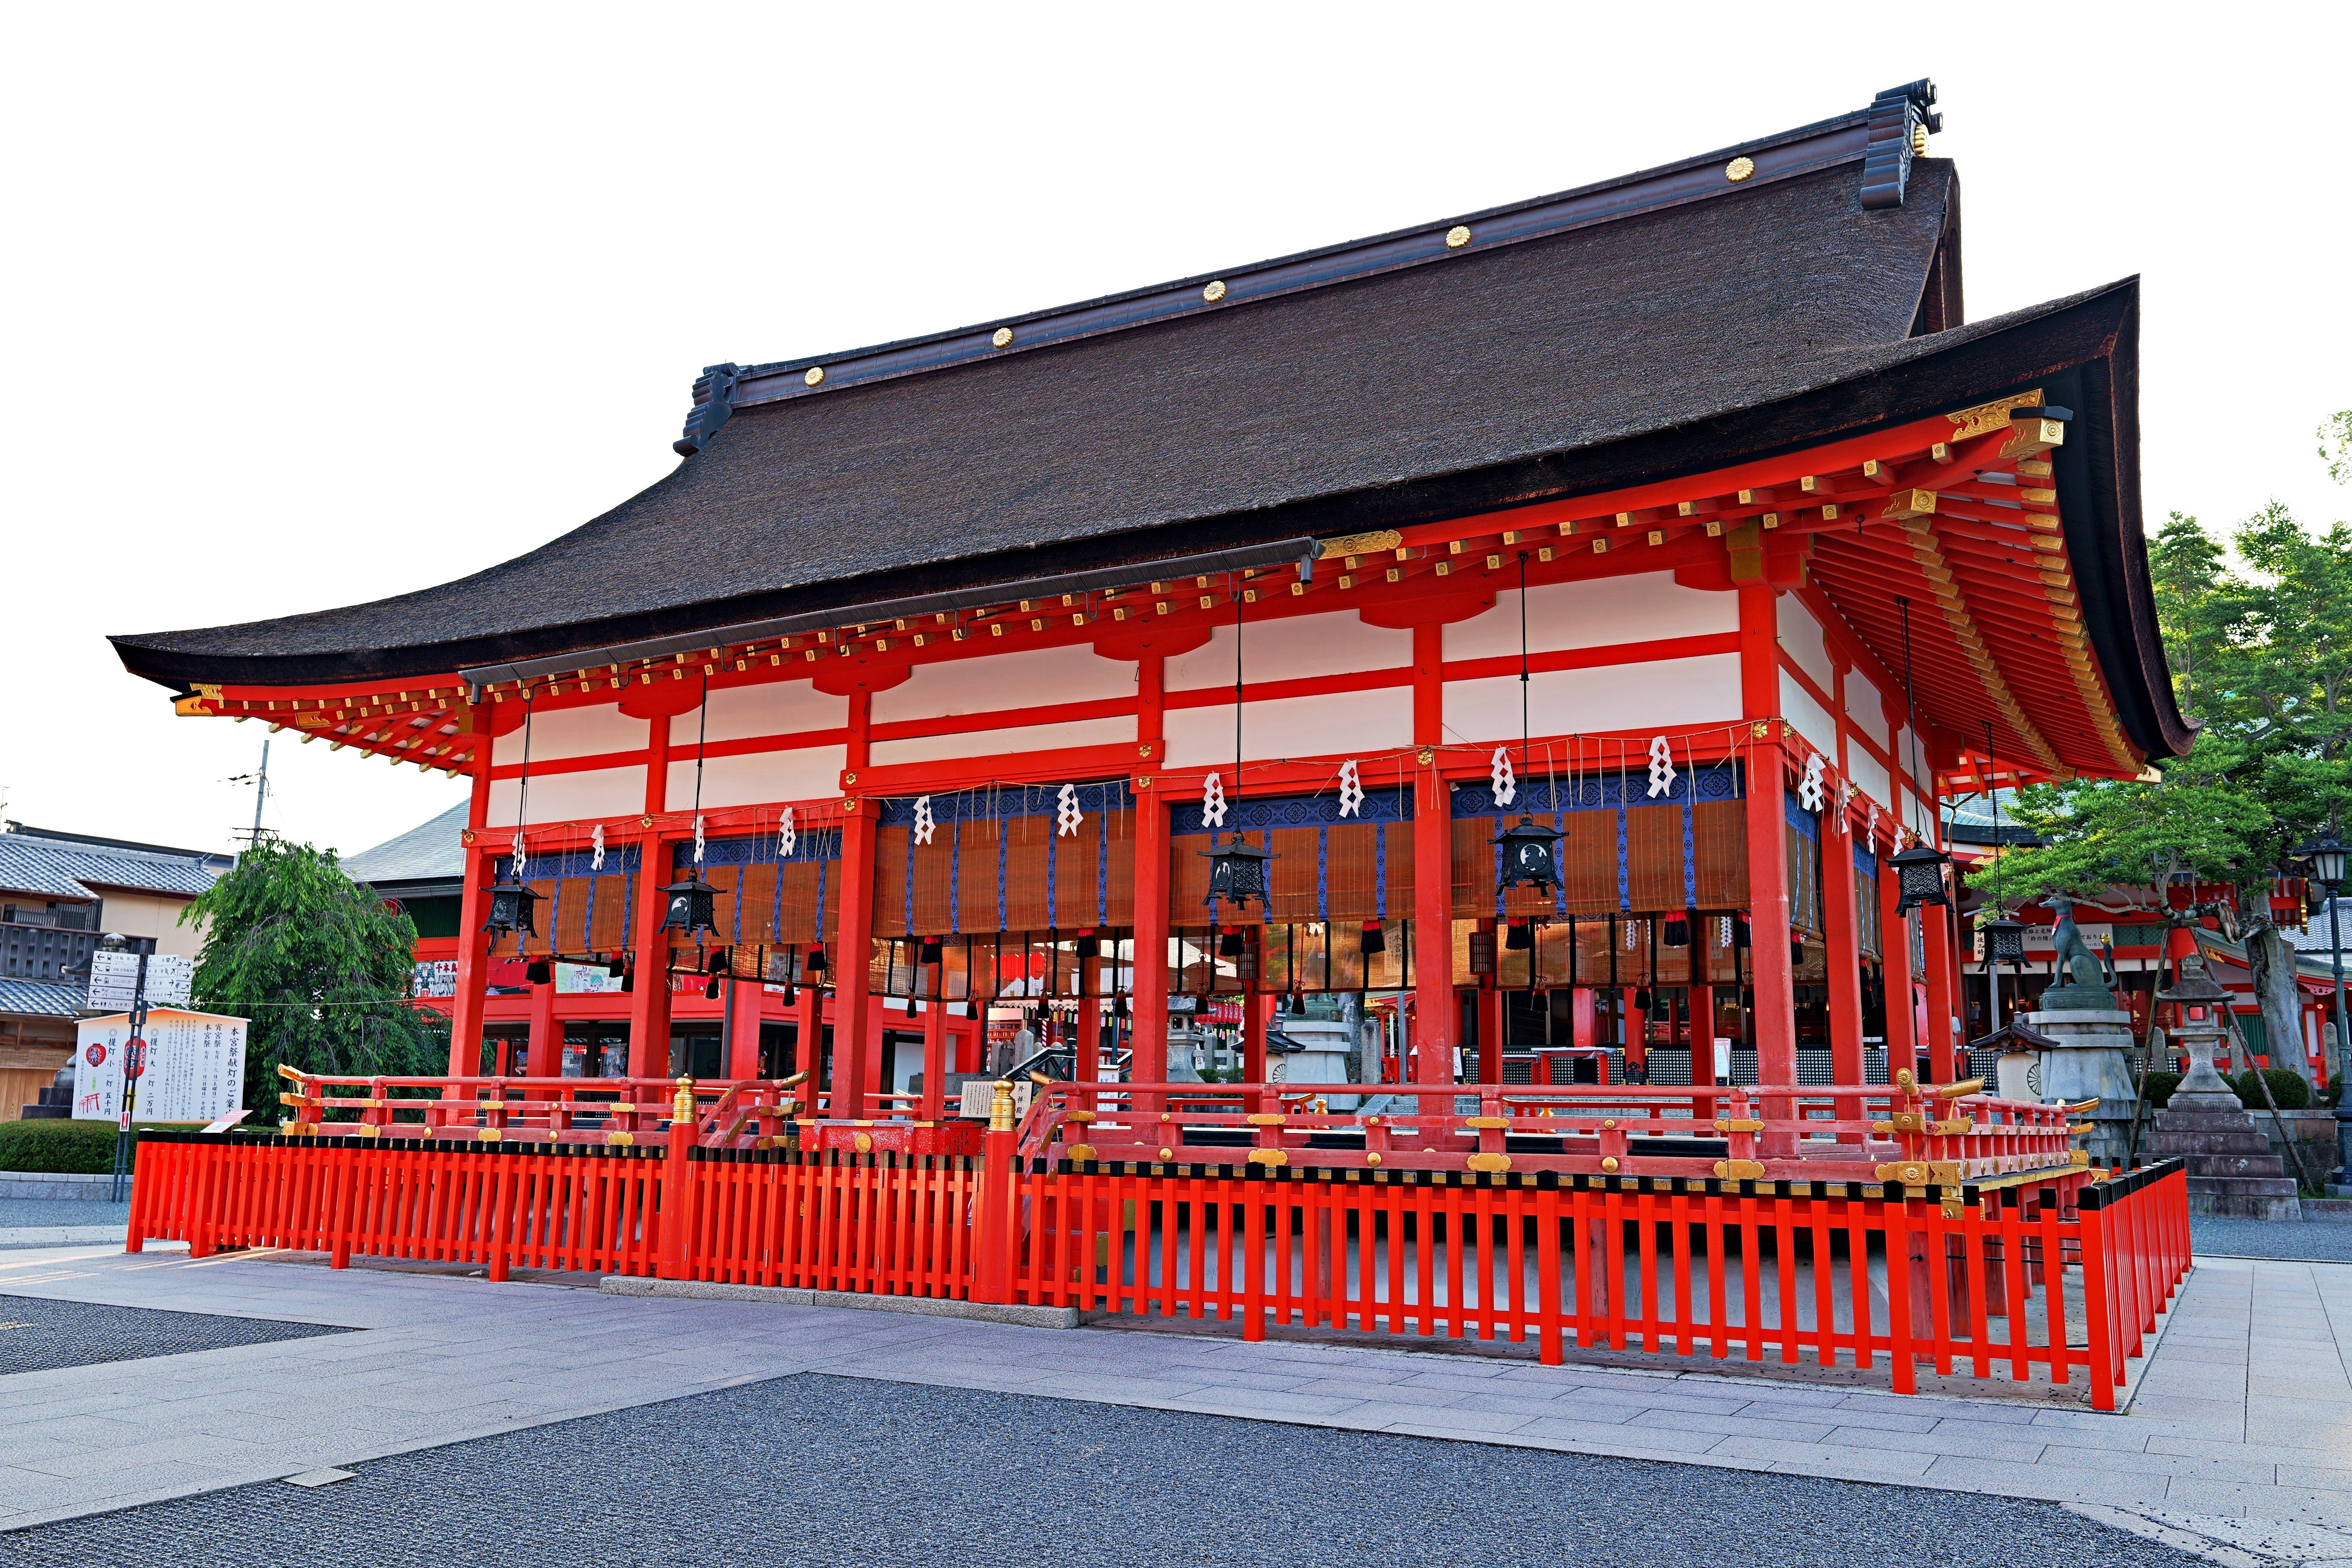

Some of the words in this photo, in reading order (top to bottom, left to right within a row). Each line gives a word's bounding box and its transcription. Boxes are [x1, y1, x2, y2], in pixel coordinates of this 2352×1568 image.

[1393, 934, 1402, 965] 本宮祭
[108, 1038, 116, 1055] 提灯
[150, 1038, 158, 1055] 提灯
[203, 1024, 212, 1047] 本宮祭
[214, 1024, 223, 1047] 宵宮祭
[1016, 1085, 1024, 1114] 外拝殿
